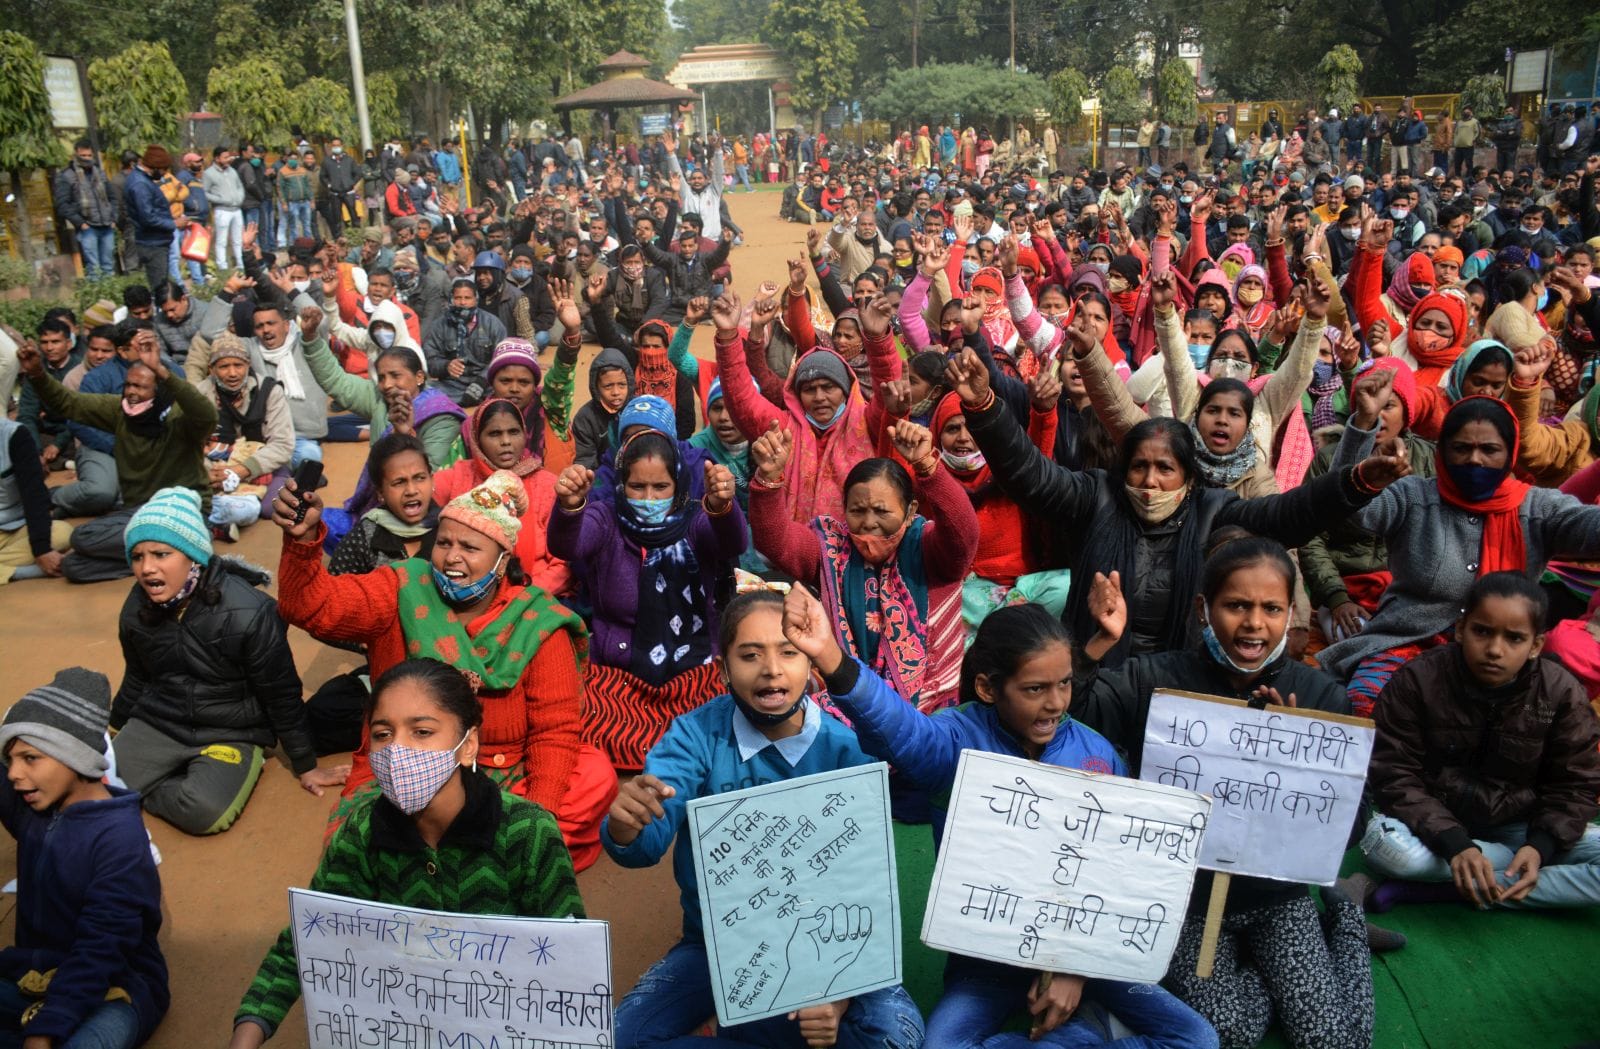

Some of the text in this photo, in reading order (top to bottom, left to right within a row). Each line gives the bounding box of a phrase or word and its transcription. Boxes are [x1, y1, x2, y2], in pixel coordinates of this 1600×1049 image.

[1166, 716, 1207, 748] 110
[981, 777, 1207, 864] चाहे जो मजबूरी
[1213, 771, 1282, 813] बहाली
[1282, 780, 1340, 824] करो
[709, 841, 731, 863] 110
[721, 907, 747, 927] हर
[749, 886, 780, 910] घर
[806, 817, 861, 877] खुशहाली
[753, 859, 774, 879] की
[780, 815, 817, 858] बहाली
[1051, 843, 1088, 887] हो
[708, 864, 739, 886] वेतन
[327, 909, 515, 963] कर्मचारी एकता
[1018, 925, 1047, 960] हो
[1034, 894, 1109, 936] हमारी
[1116, 903, 1169, 954] पूरी
[302, 948, 357, 998] करायी
[405, 970, 516, 1020] कर्मचारियों
[516, 980, 549, 1024] की
[546, 984, 612, 1030] बहाली
[727, 941, 770, 1004] कर्मचारी एकता
[315, 1004, 359, 1049] तभी
